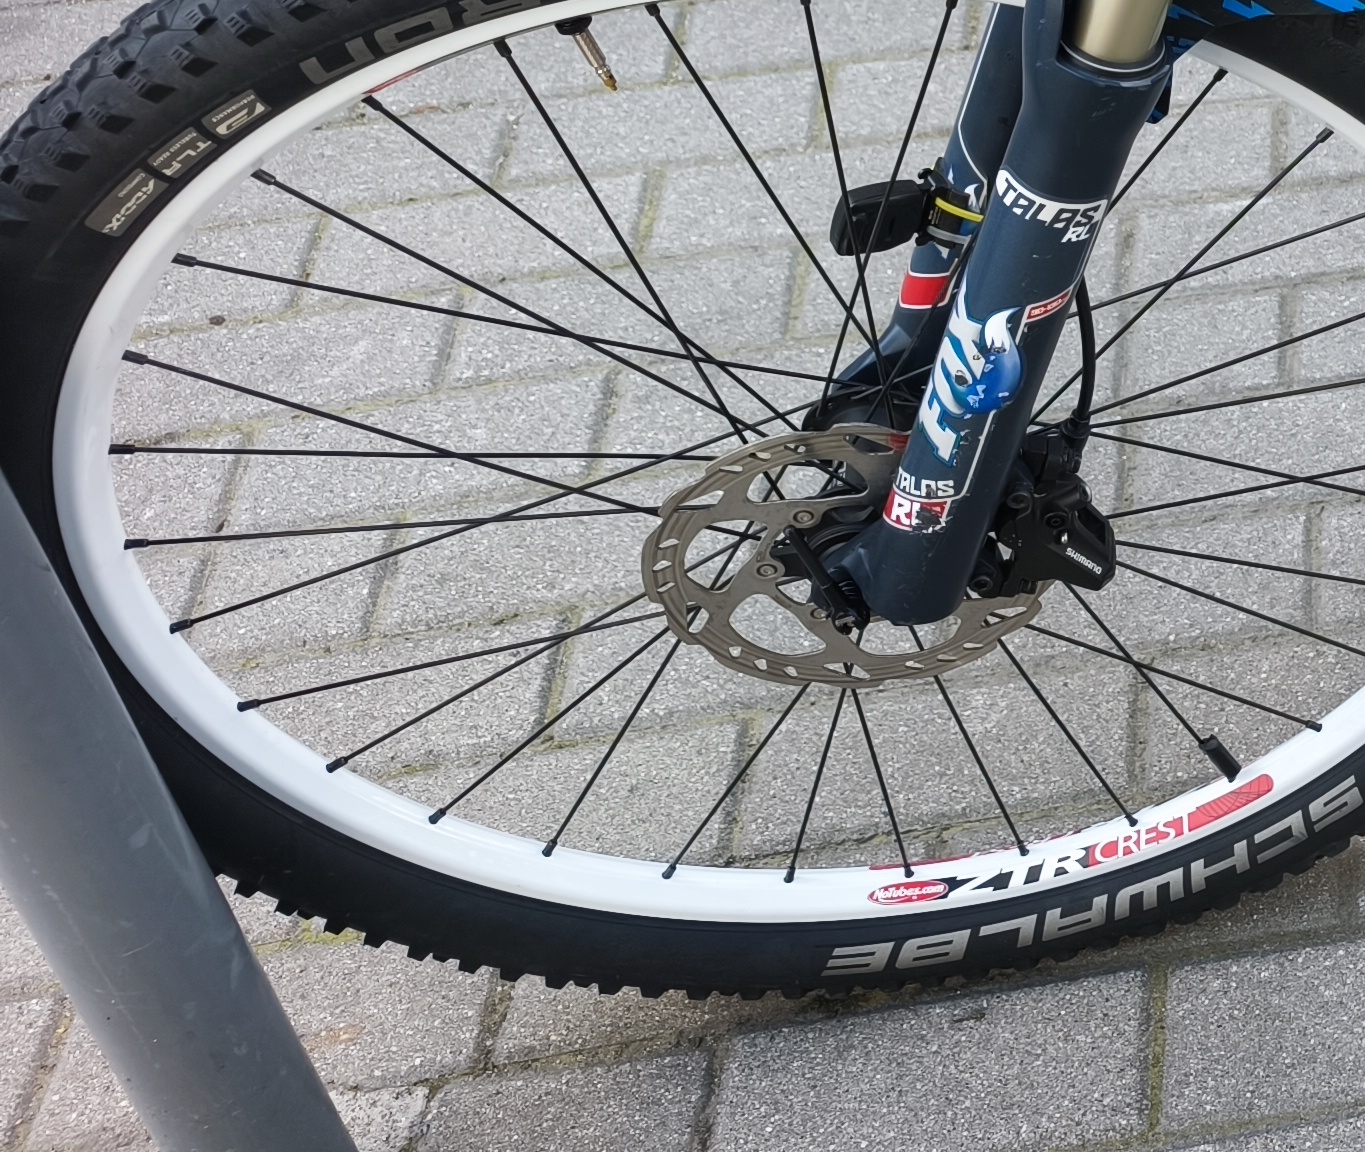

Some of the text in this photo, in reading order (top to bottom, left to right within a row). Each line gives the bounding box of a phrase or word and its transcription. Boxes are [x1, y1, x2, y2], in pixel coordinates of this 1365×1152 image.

[161, 140, 212, 177] TLR
[1065, 547, 1103, 575] SHIMANO
[821, 775, 1364, 977] SCHWALBE
[872, 815, 1198, 900] NoTubes.com ZTR CREST
